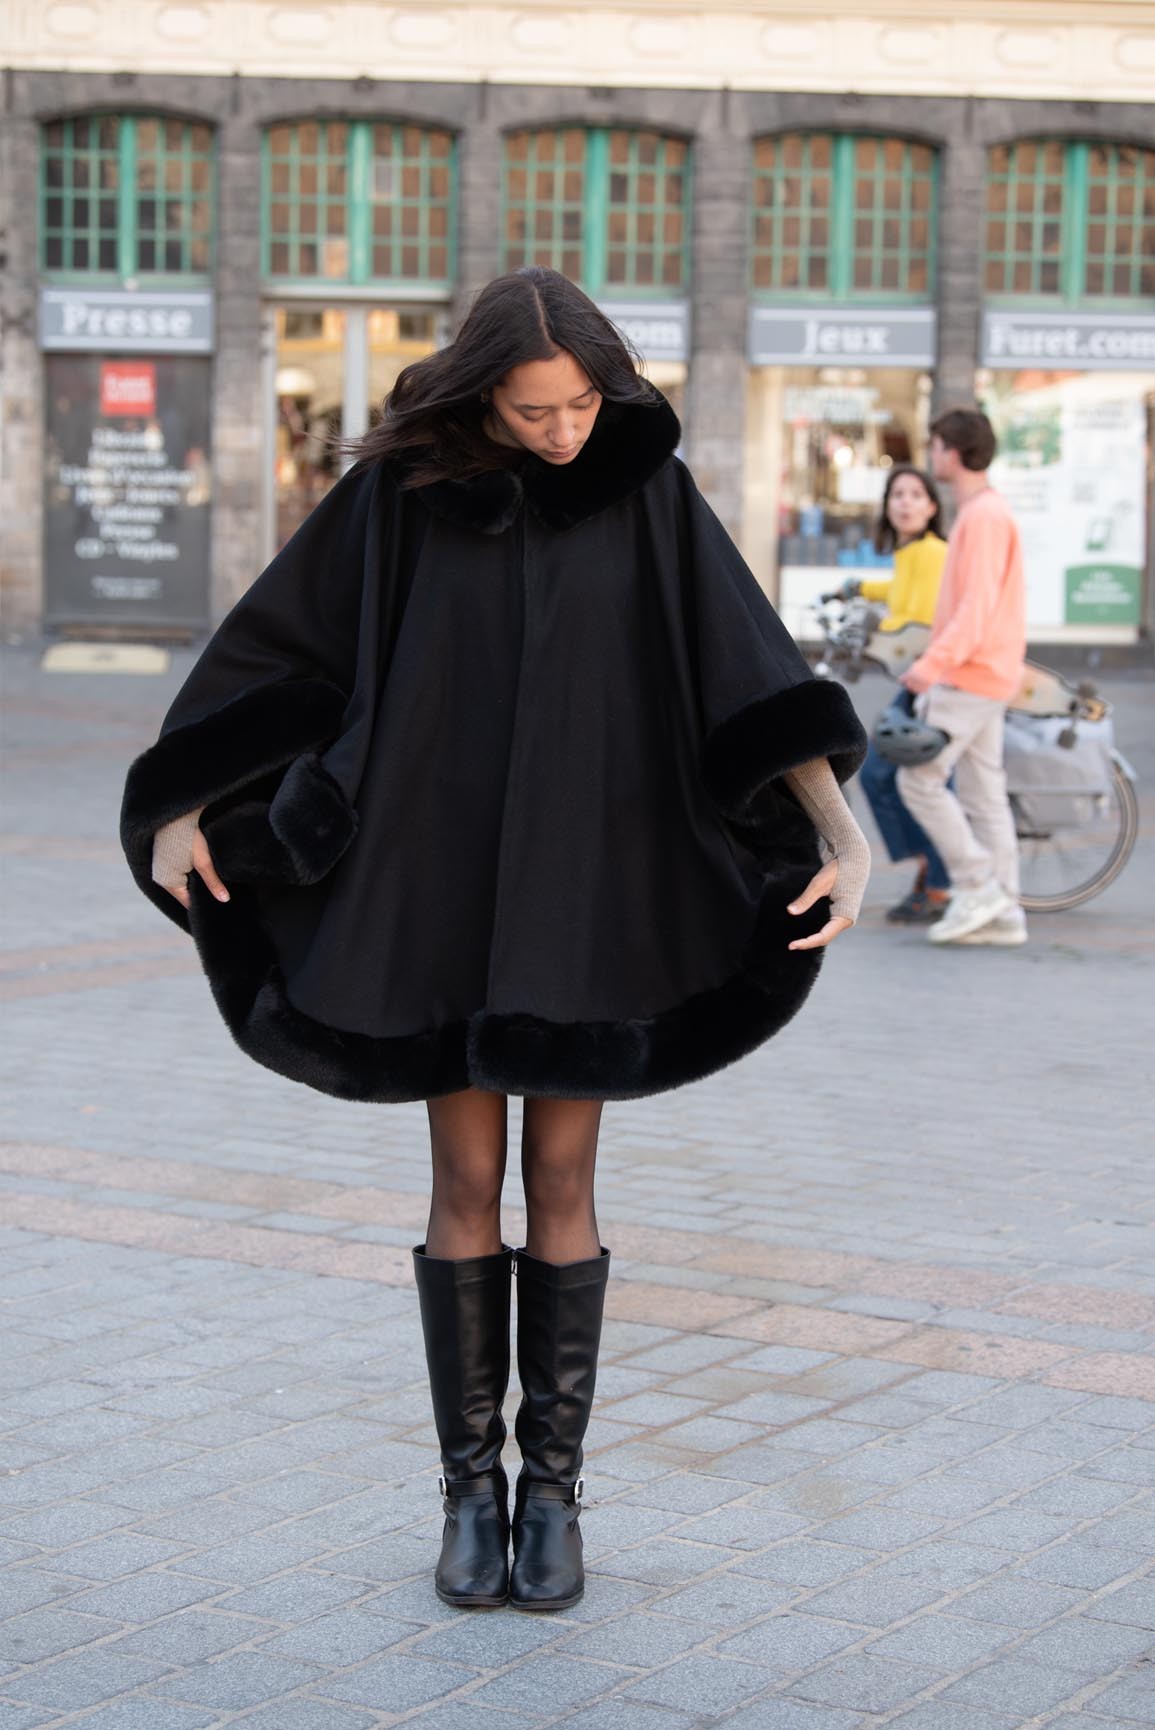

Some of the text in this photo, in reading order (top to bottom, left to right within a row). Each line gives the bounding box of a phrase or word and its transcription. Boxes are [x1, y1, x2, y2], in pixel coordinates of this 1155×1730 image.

[62, 303, 192, 336] Presse
[800, 320, 889, 357] Jeux
[990, 325, 1155, 359] Furet.com
